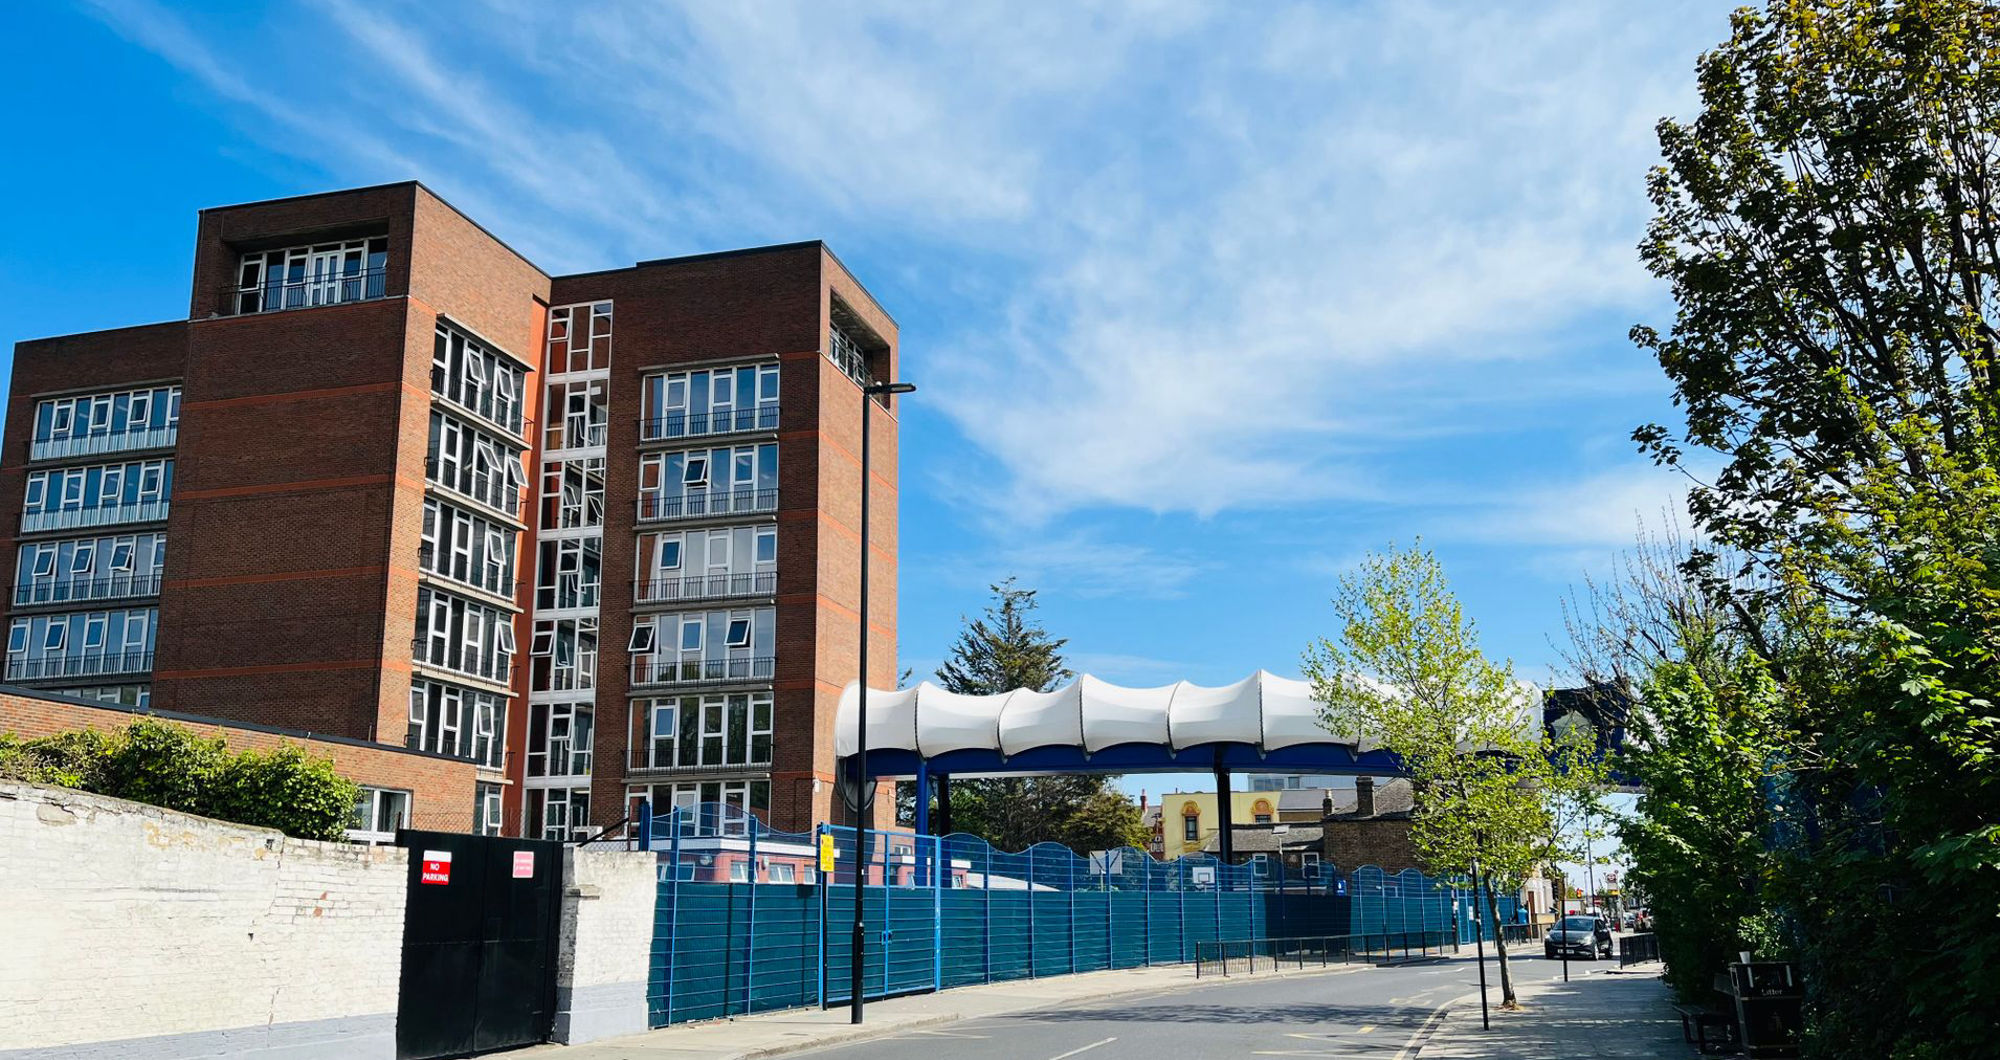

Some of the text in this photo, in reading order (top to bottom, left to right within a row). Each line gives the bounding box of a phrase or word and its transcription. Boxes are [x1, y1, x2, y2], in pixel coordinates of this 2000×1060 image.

[430, 863, 440, 871] NO
[423, 872, 449, 882] PARKING
[1761, 988, 1783, 996] Litter
